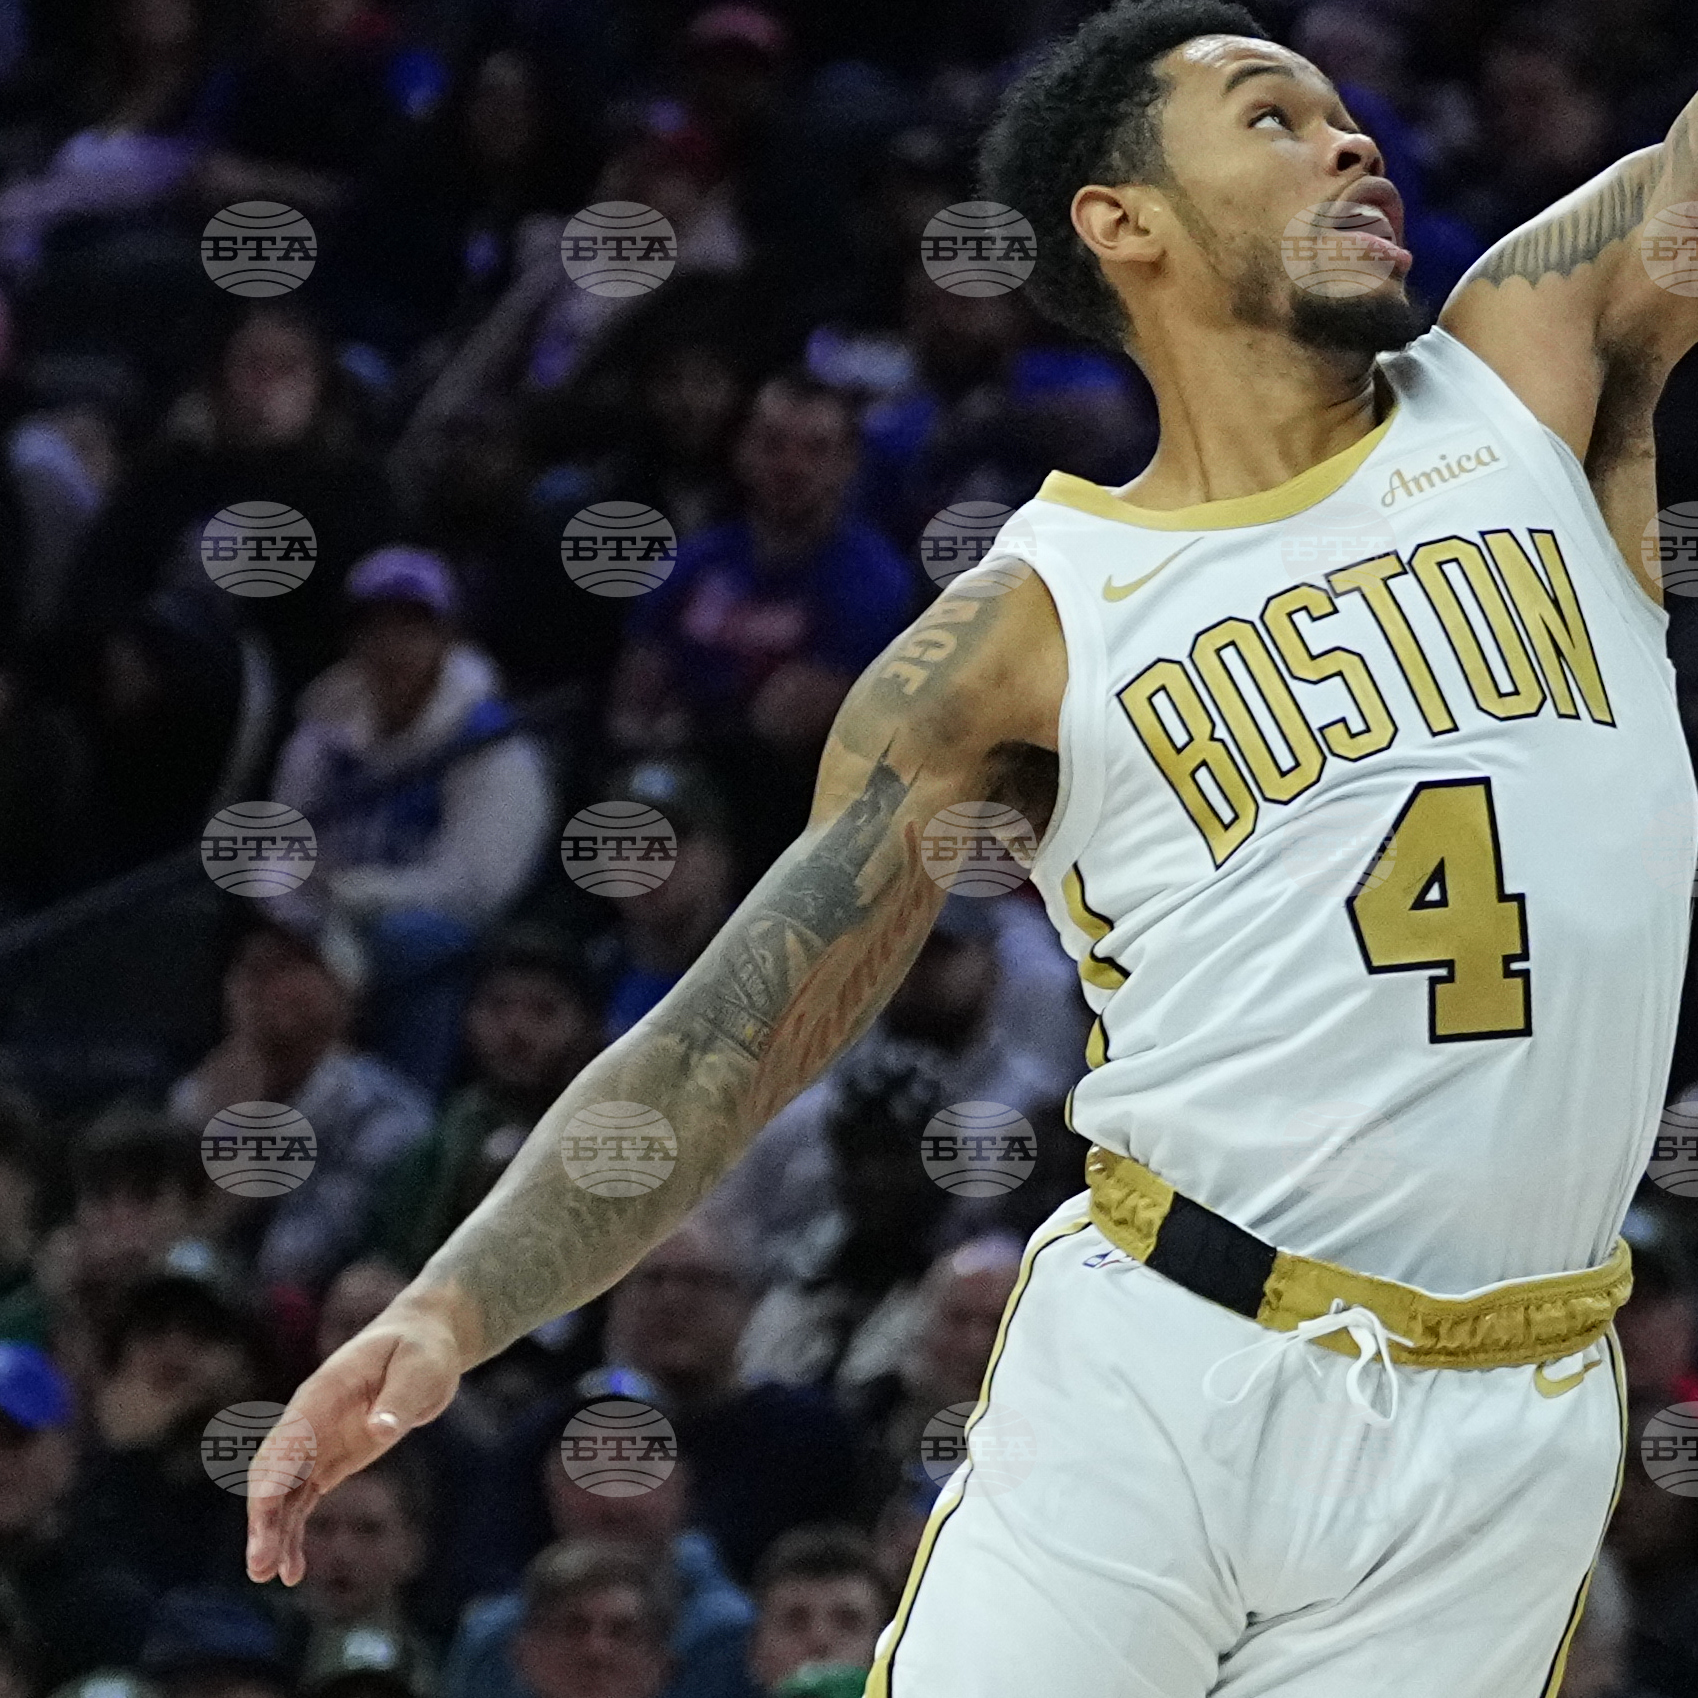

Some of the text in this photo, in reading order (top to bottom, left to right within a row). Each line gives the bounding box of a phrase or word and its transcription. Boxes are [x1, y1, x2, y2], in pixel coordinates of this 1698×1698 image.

[1381, 445, 1500, 508] Amica
[1115, 528, 1618, 871] BOSTON
[1344, 776, 1533, 1045] 4
